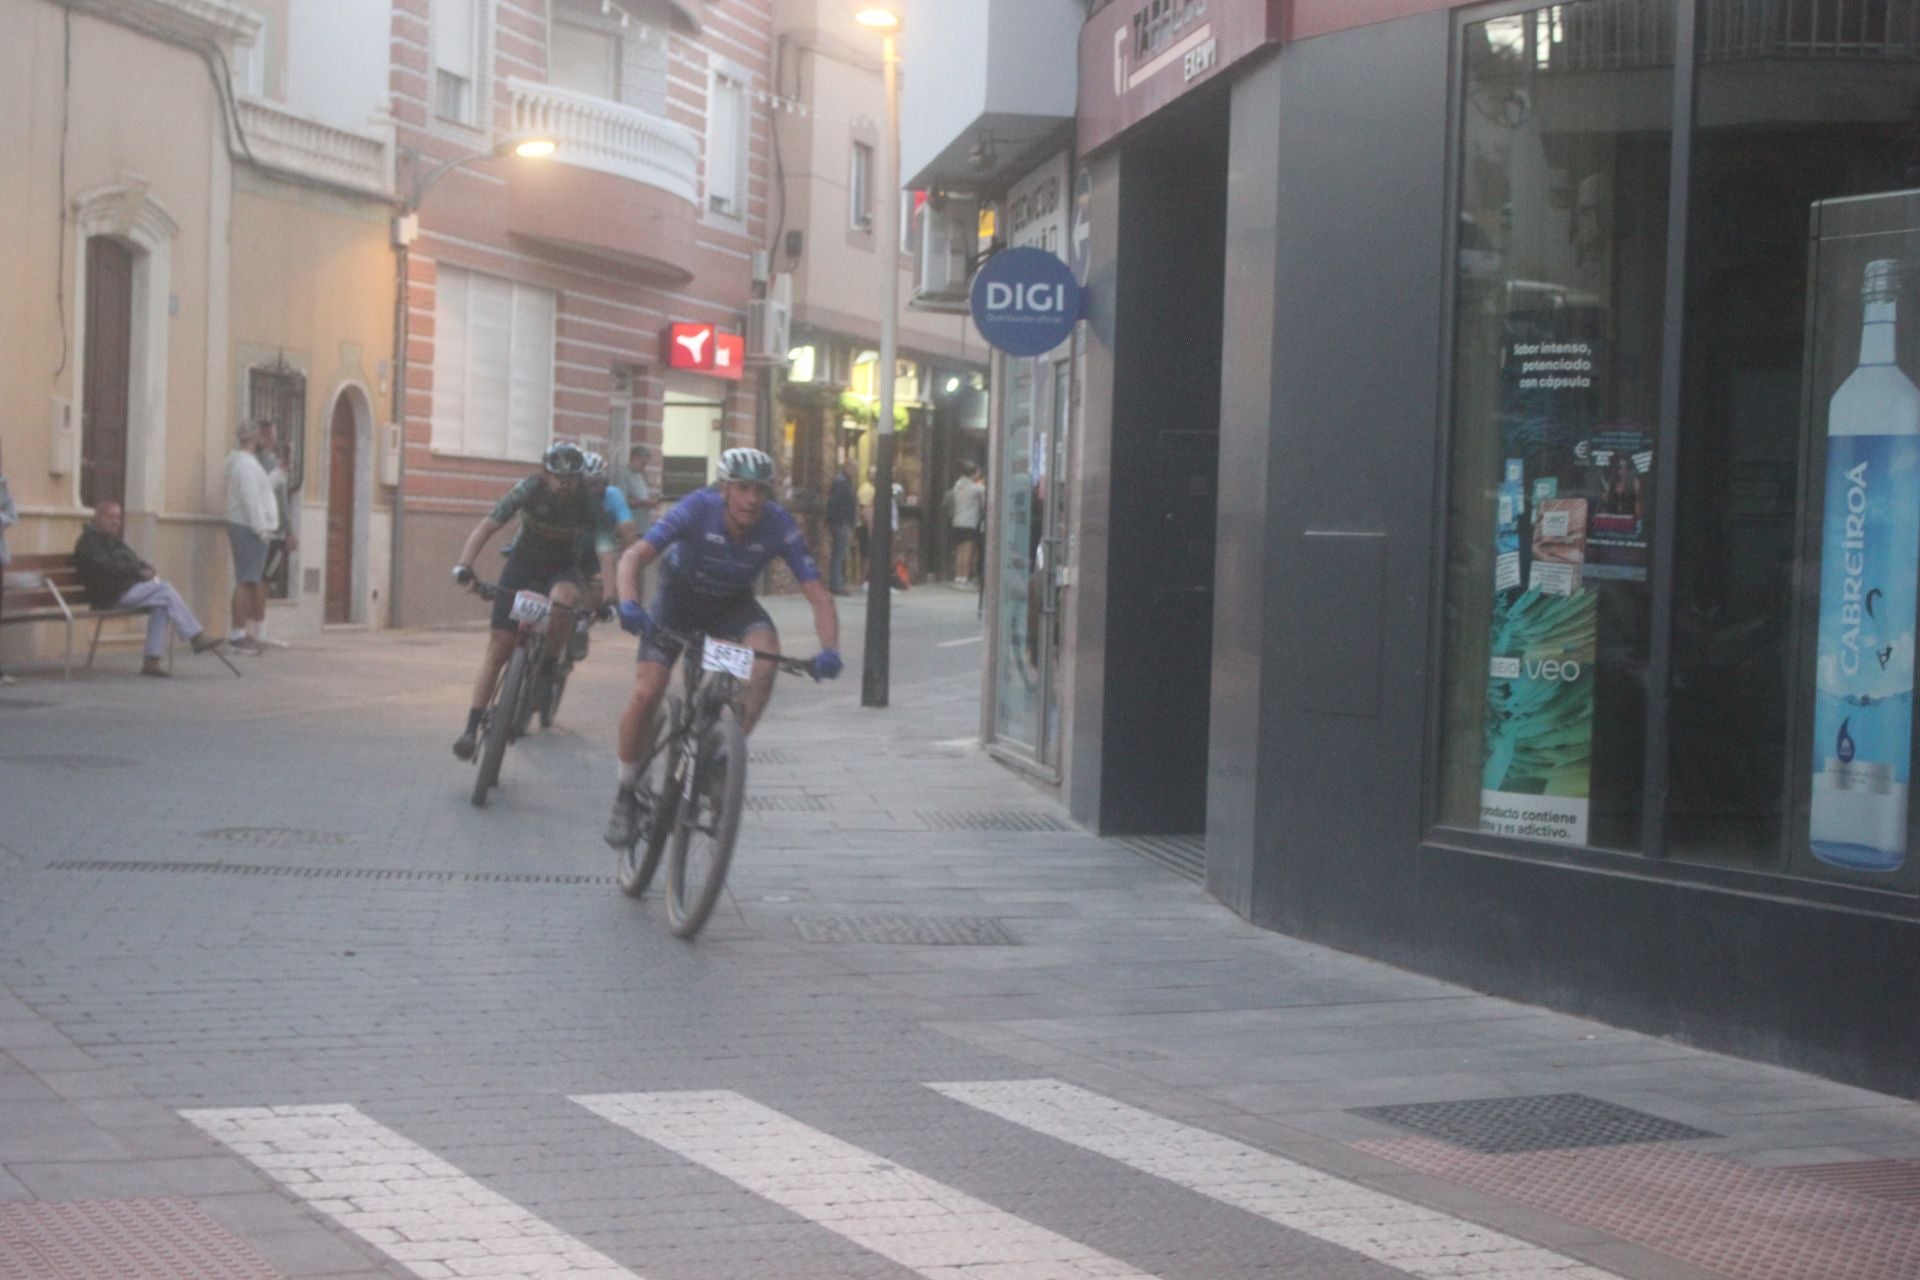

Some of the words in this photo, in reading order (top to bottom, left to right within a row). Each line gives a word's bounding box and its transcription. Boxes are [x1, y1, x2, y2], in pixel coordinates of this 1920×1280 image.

[986, 282, 1064, 312] DIGI
[1540, 341, 1591, 356] intenso,
[1522, 358, 1591, 374] potenciado
[1539, 375, 1591, 390] cápsula
[1526, 659, 1580, 681] veo
[1521, 809, 1577, 825] contiene
[1517, 822, 1571, 839] adictivo.
